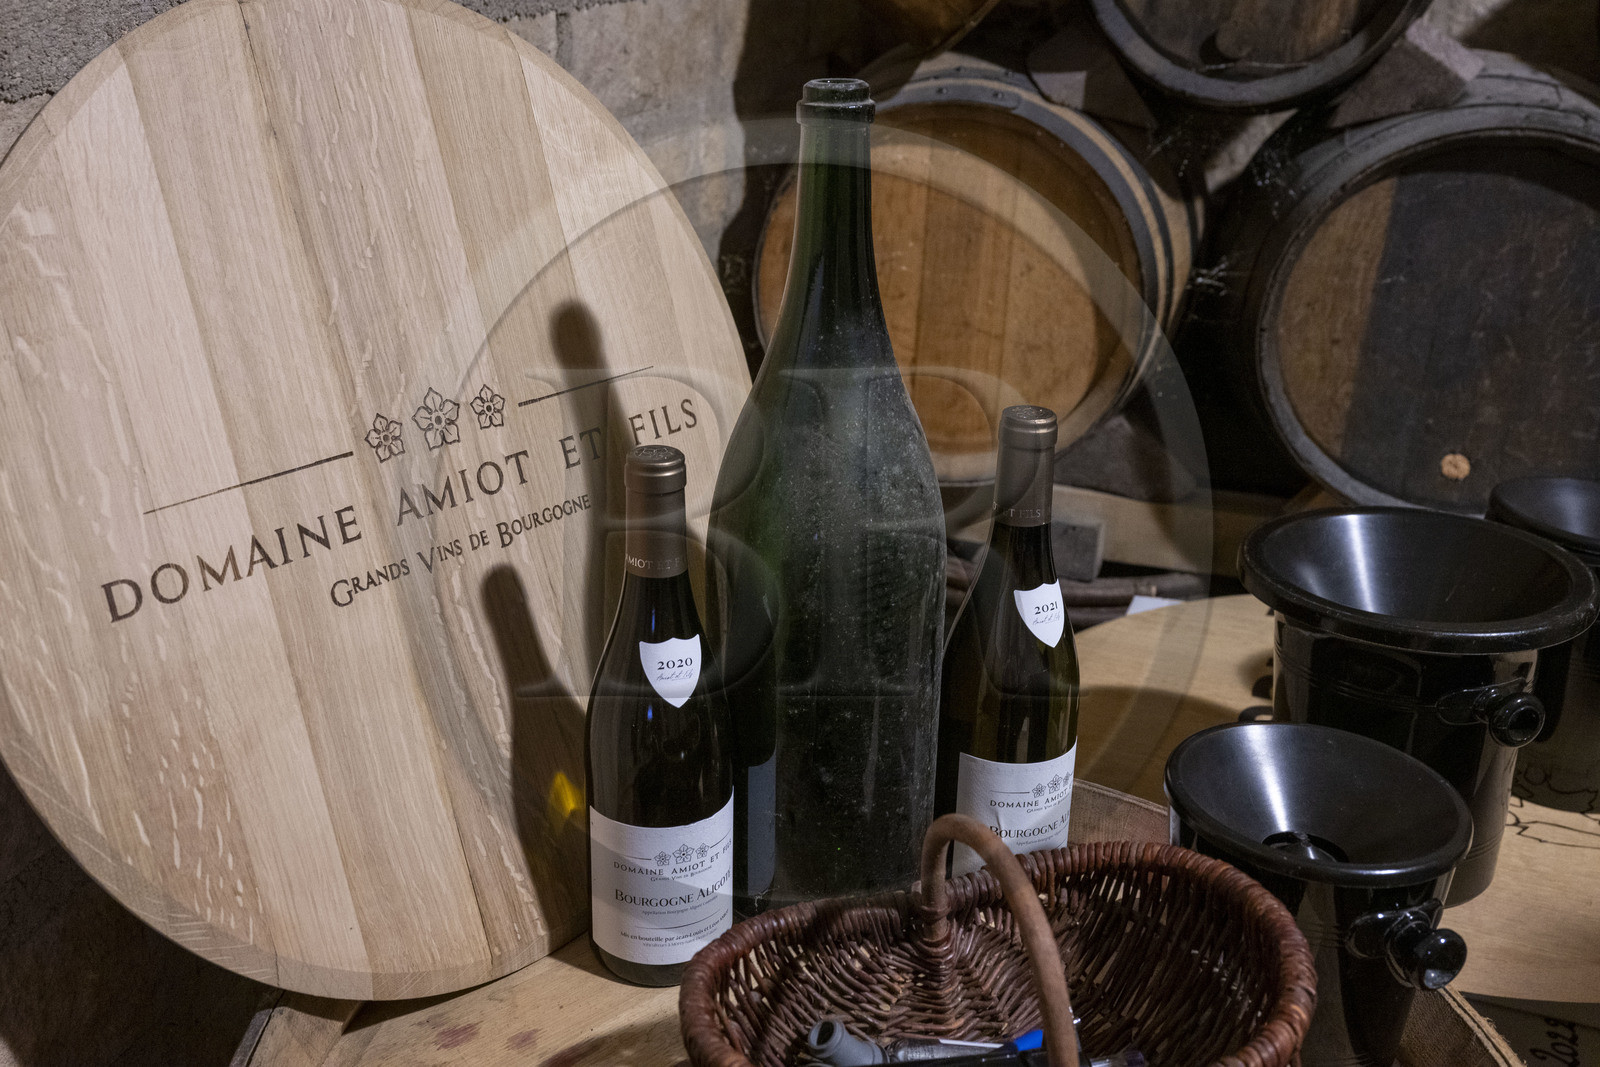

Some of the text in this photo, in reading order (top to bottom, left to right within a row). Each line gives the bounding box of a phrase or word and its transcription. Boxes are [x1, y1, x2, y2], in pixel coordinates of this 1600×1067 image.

[101, 398, 699, 623] DOMAINE AMIOT ET FILS
[330, 493, 592, 609] GRANDS VINS DE BOURGOGNE
[1034, 601, 1058, 615] 2021
[657, 657, 693, 670] 2020
[989, 800, 1039, 809] DOMAINE
[1044, 788, 1068, 805] AMIOT
[989, 820, 1058, 839] BOURGOGNE
[613, 861, 664, 876] DOMAINE
[671, 860, 706, 875] AMIOT
[710, 852, 720, 863] ET
[615, 888, 695, 908] BOURGOGNE
